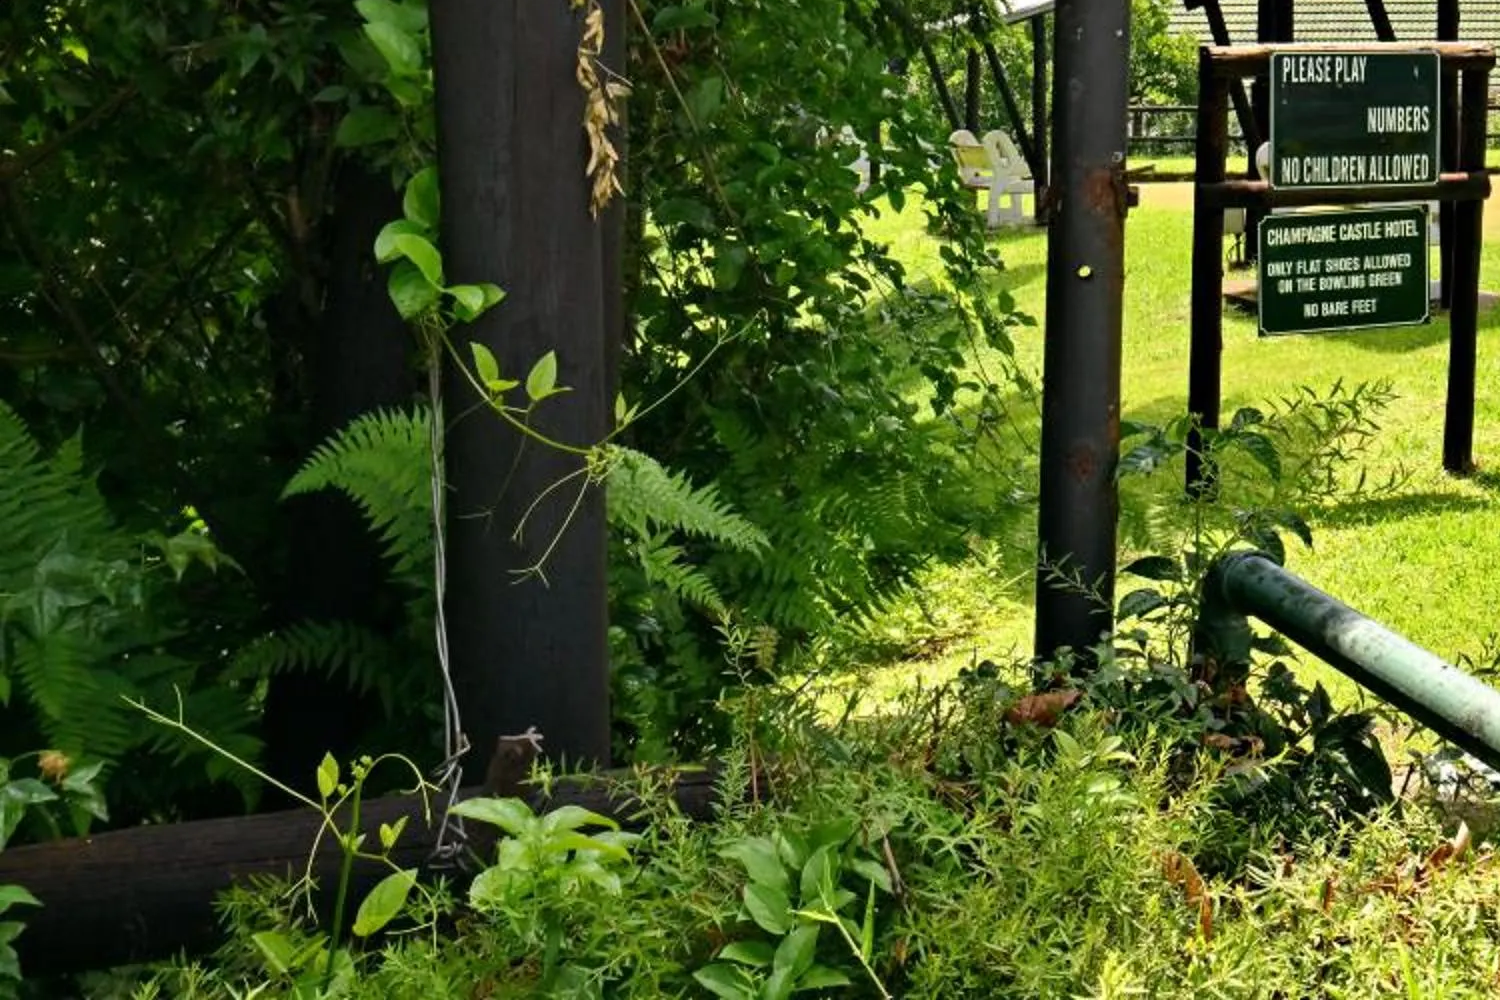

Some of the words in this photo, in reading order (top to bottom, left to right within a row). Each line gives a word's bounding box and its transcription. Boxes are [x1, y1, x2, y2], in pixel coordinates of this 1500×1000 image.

[1282, 56, 1332, 83] PLEASE
[1335, 56, 1367, 83] PLAY
[1368, 106, 1429, 133] NUMBERS
[1282, 157, 1299, 184] NO
[1303, 156, 1365, 183] CHILDREN
[1369, 154, 1429, 182] ALLOWED
[1267, 224, 1336, 246] CHAMPAGNE
[1340, 221, 1381, 241] CASTLE
[1385, 220, 1419, 238] HOTEL
[1267, 261, 1293, 276] ONLY
[1297, 259, 1321, 275] FLAT
[1326, 257, 1359, 272] SHOES
[1363, 253, 1411, 270] ALLOWED
[1278, 279, 1293, 294] ON
[1297, 277, 1316, 291] THE
[1319, 274, 1365, 291] BOWLING
[1369, 272, 1403, 286] GREEN
[1304, 303, 1319, 318] NO
[1322, 300, 1349, 316] BARE
[1352, 299, 1377, 314] FEET
